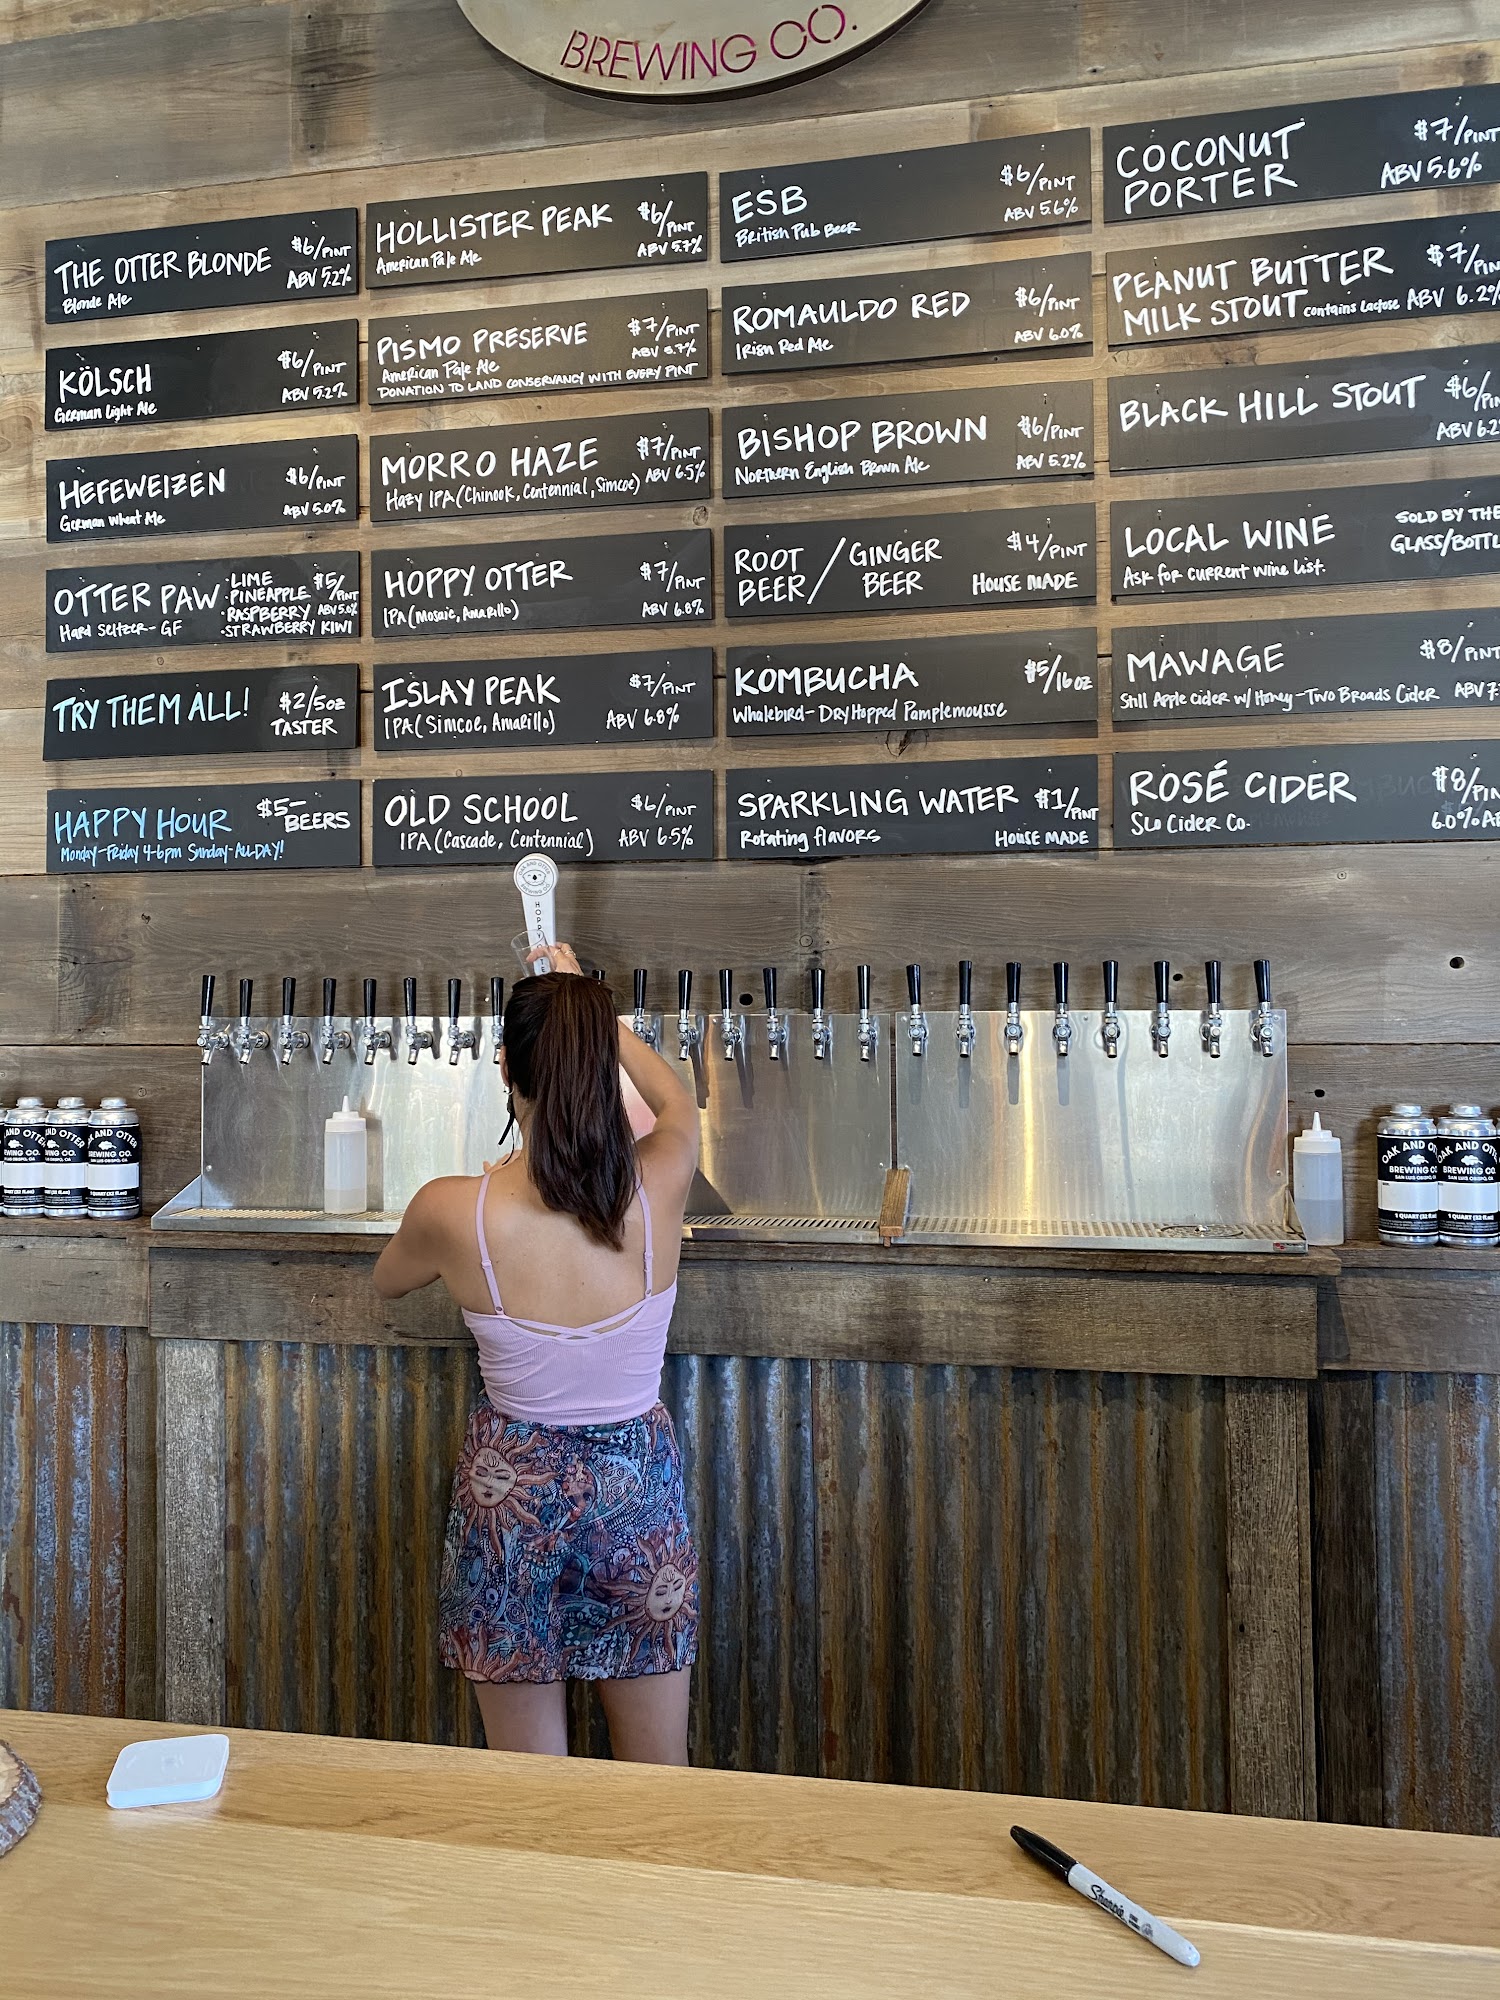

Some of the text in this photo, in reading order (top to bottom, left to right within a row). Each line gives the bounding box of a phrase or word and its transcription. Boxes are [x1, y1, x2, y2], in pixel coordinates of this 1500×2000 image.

[560, 3, 859, 82] BREWING CO.
[1117, 122, 1305, 180] COCONUT
[1381, 152, 1482, 188] ABV 5.6%
[1122, 162, 1298, 214] PORTER
[732, 186, 807, 223] ESB
[377, 204, 612, 255] HOLLISTER PEAK
[735, 222, 861, 247] British Pub Beer
[54, 247, 271, 294] THE OTTER BLONDE
[376, 250, 482, 275] American Pale Ale
[1113, 245, 1394, 304] PEANUT BUTTER
[287, 264, 351, 289] ABV 5.2%
[62, 293, 132, 314] Blonde Ale
[733, 291, 970, 335] ROMAULDO RED
[1124, 289, 1356, 336] MILK STOUT contains
[377, 322, 587, 366] PISMO PRESERVE
[736, 337, 834, 360] Irish Red Ale
[60, 364, 151, 403] KÖLSCH
[377, 363, 698, 398] DONATION TO LAND CONSERVANCY WITH EVERY PINT
[382, 359, 499, 383] American Pale Ale
[55, 407, 102, 423] German
[137, 401, 157, 415] Ale
[1120, 375, 1426, 432] BLACK HILL STOUT
[738, 416, 986, 460] BISHOP BROWN
[382, 436, 598, 485] MORRO HAZE
[735, 455, 930, 485] Northern English Brown Ale
[59, 467, 225, 510] HEFEWEIZEN
[386, 473, 640, 512] Hazy Centennial, Simcoe)
[60, 511, 166, 532] German Ale
[1395, 505, 1500, 523] SOLD BY THE
[1125, 514, 1335, 557] LOCAL WINE
[735, 548, 804, 574] ROOT
[849, 539, 942, 566] GINGER
[231, 571, 273, 588] LIME
[385, 561, 573, 598] HOPPY OTTER
[862, 571, 923, 598] BEER
[973, 572, 1078, 595] HOUSE MADE
[1124, 561, 1289, 588] Ask for current wine
[54, 583, 220, 617] OTTER PAW
[230, 586, 311, 605] PINEAPPLE
[739, 575, 805, 606] BEER
[227, 604, 311, 622] RASPBERRY
[60, 620, 182, 642] Hard GF
[225, 619, 352, 637] STRAWBERRY KIWI
[1127, 643, 1284, 682] MAWAGE
[382, 674, 560, 713] ISLAY PEAK
[735, 663, 919, 697] KOMBUCHA
[53, 687, 249, 732] TRY THEM ALL!
[1120, 684, 1440, 709] Still Apple w/ Broads Cider
[607, 703, 679, 730] ABV 6.8%
[904, 701, 1007, 723] Pamplemousse
[270, 718, 337, 736] TASTER
[1130, 760, 1357, 806] ROSÉ CIDER
[385, 792, 578, 827] OLD SCHOOL
[738, 785, 1019, 820] SPARKLING WATER
[55, 807, 232, 844] HAPPY HOUR
[284, 812, 350, 832] BEERS
[1167, 814, 1221, 833] Cider
[510, 828, 593, 856] Centennial)
[619, 825, 693, 850] ABV 6.5%
[741, 826, 881, 852] Rotating flavors
[996, 828, 1089, 847] HOUSE MADE
[59, 1129, 86, 1149] OTTER
[95, 1129, 138, 1149] AND OTTER
[1382, 1140, 1426, 1164] OAK AND
[1455, 1141, 1480, 1151] AND
[1389, 1166, 1430, 1174] BREWING
[1443, 1166, 1484, 1175] BREWING
